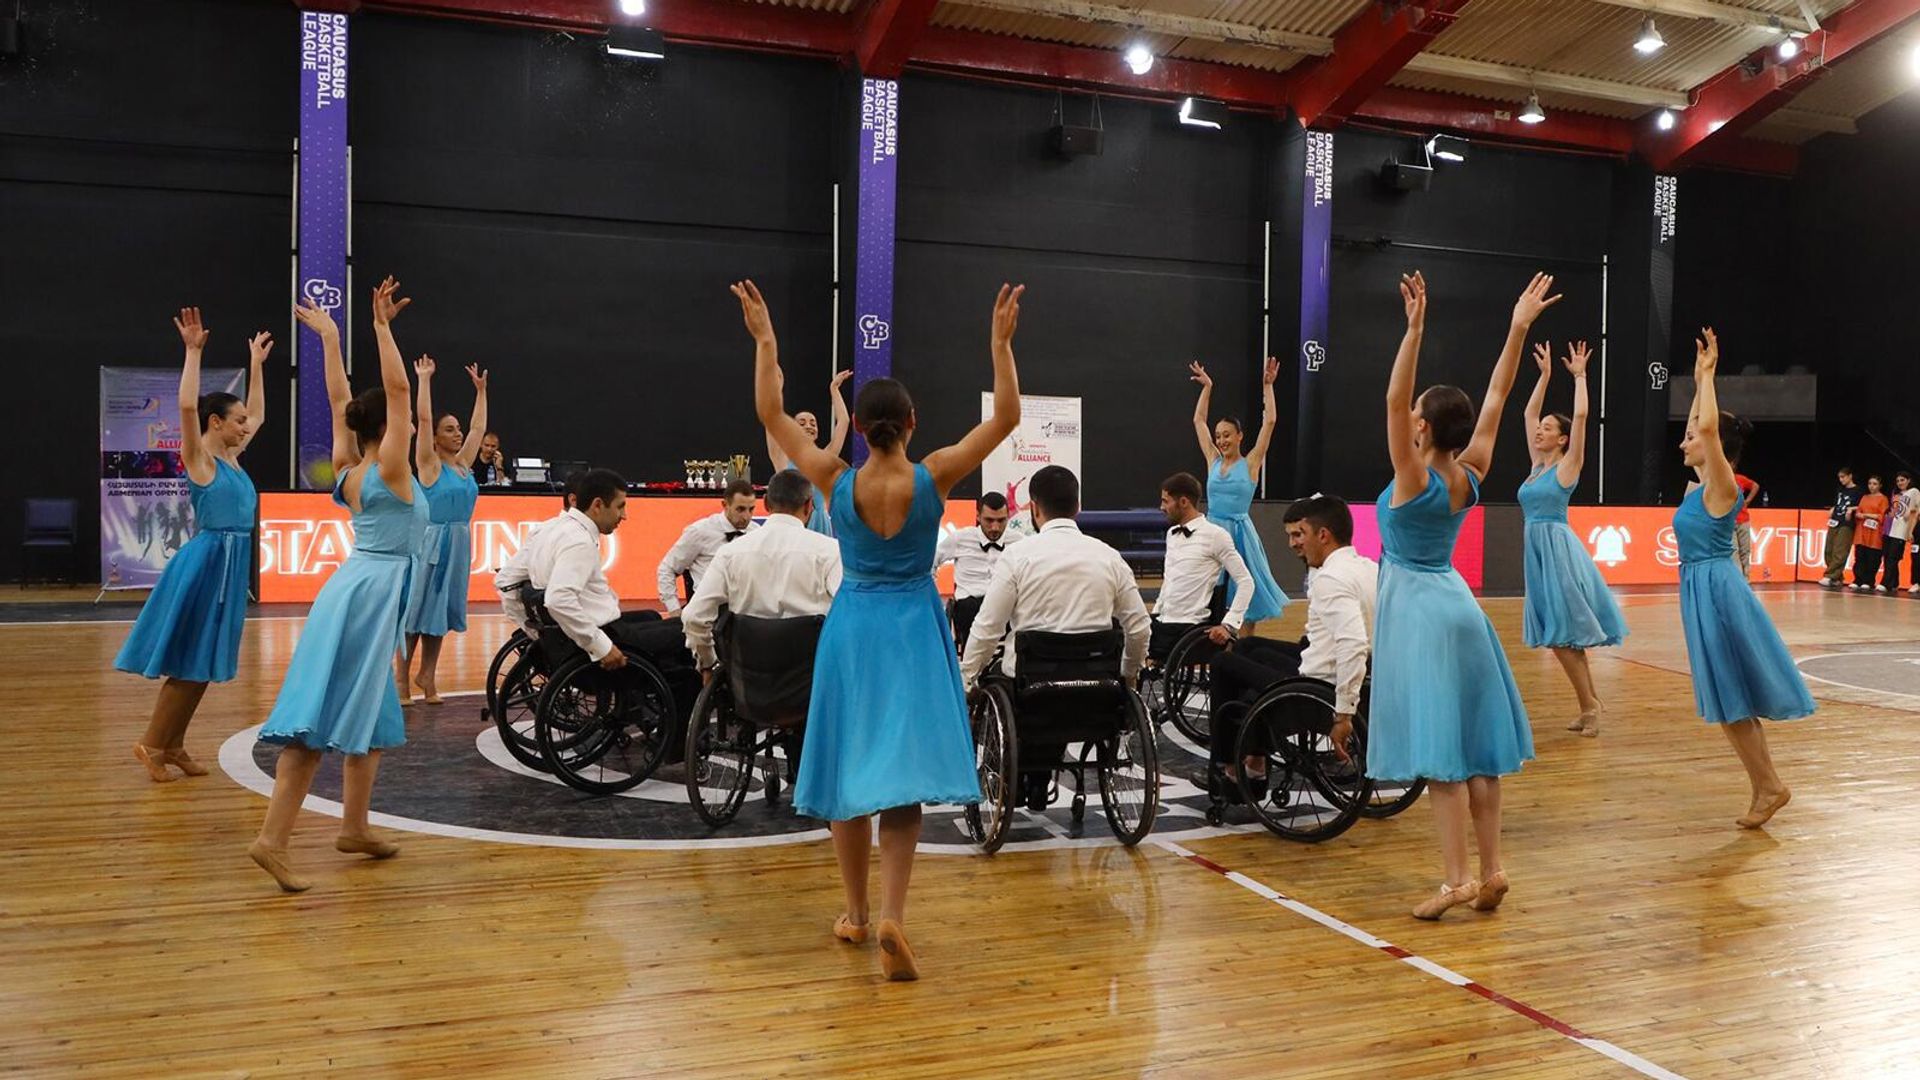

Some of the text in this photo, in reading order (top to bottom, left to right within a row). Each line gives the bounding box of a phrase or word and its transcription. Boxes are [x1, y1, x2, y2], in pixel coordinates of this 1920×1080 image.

[303, 11, 317, 70] LEAGUE
[317, 13, 331, 109] BASKETBALL
[332, 14, 346, 99] CAUCASUS
[862, 78, 874, 130] LEAGUE
[873, 79, 886, 164] BASKETBALL
[885, 80, 897, 155] CAUCASUS
[1305, 130, 1315, 177] LEAGUE
[1314, 131, 1325, 207] BASKETBALL
[1324, 132, 1333, 199] CAUCASUS
[1654, 175, 1662, 216] LEAGUE
[1660, 175, 1670, 243] BASKETBALL
[1668, 176, 1677, 236] CAUCASUS
[304, 278, 341, 314] CB
[859, 314, 889, 349] CBL
[1303, 340, 1325, 371] CBL
[1648, 361, 1668, 390] CBL
[1017, 454, 1051, 463] ALLIANCE
